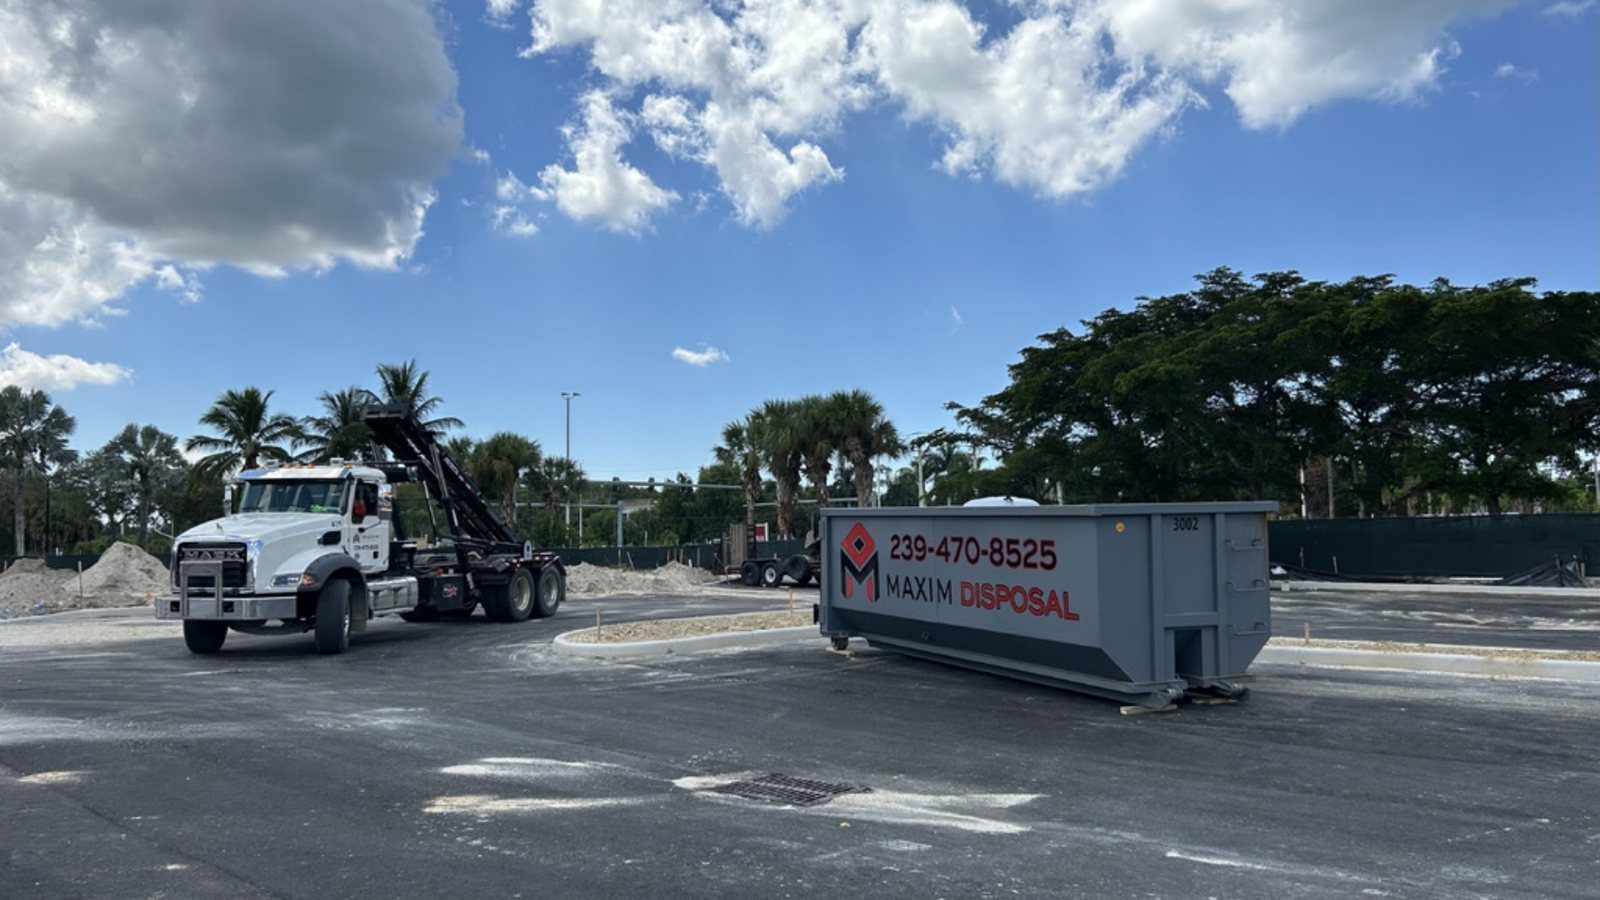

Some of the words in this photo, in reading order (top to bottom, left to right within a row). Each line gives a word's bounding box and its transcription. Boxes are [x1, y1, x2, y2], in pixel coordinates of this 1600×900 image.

[1173, 516, 1199, 531] 3002
[890, 533, 1058, 572] 239-470-8525
[886, 573, 953, 605] MAXIM
[959, 580, 1080, 621] DISPOSAL
